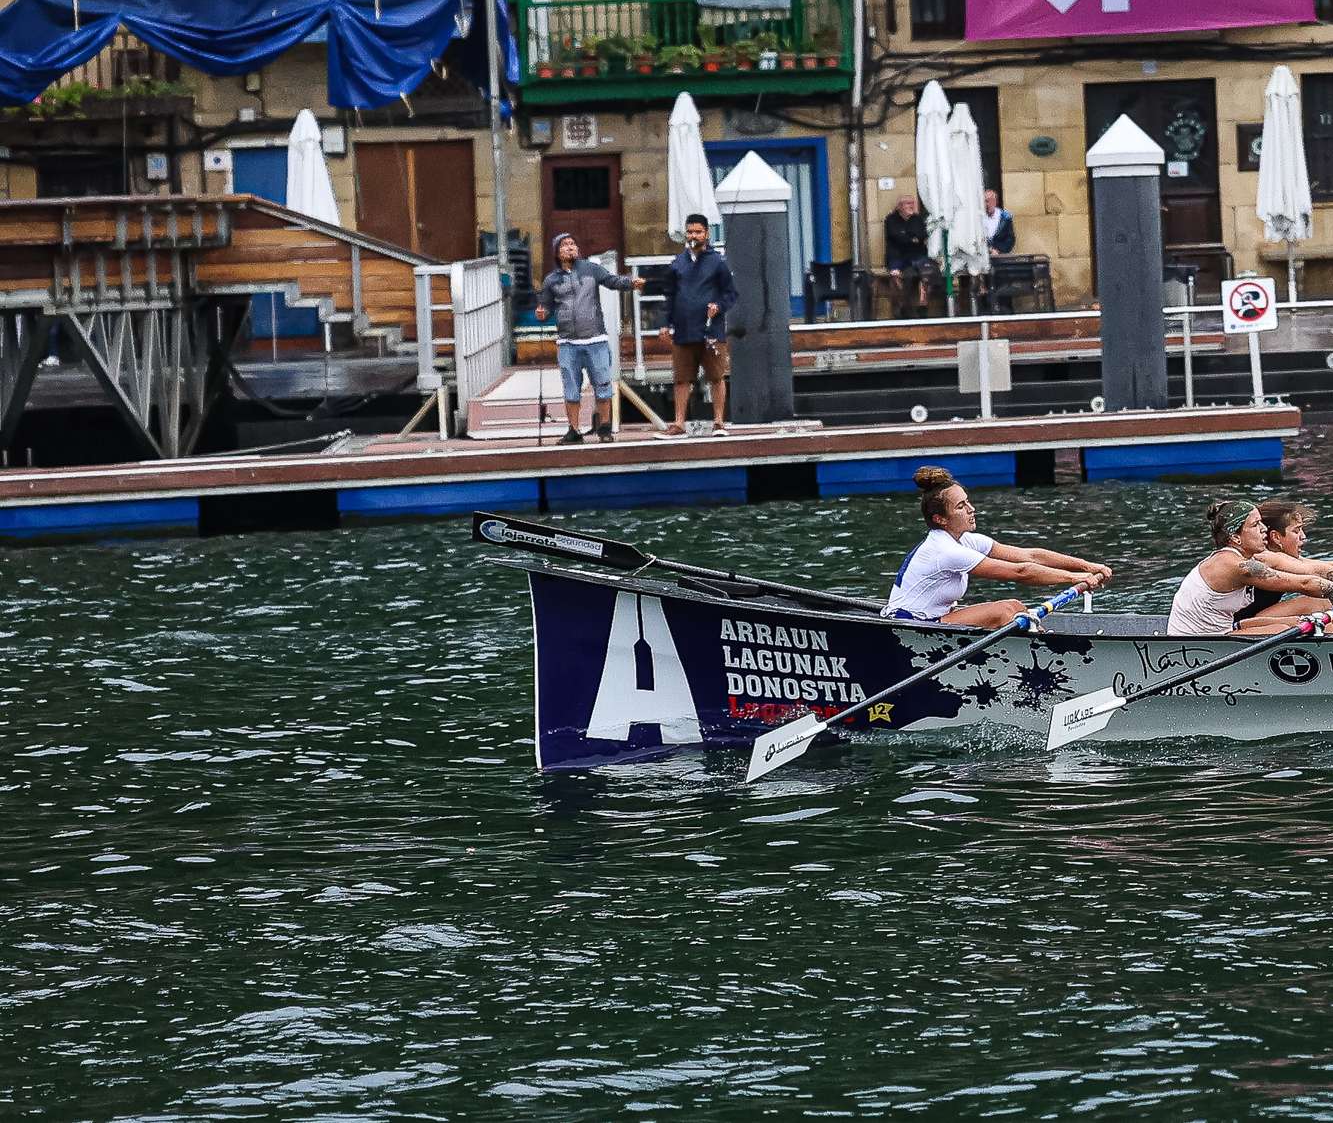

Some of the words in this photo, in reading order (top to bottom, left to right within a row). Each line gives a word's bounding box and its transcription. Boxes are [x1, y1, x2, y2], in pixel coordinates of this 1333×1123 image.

[720, 618, 830, 652] ARRAUN
[586, 591, 703, 745] A
[722, 645, 851, 679] LAGUNAK
[726, 672, 868, 704] DONOSTIA
